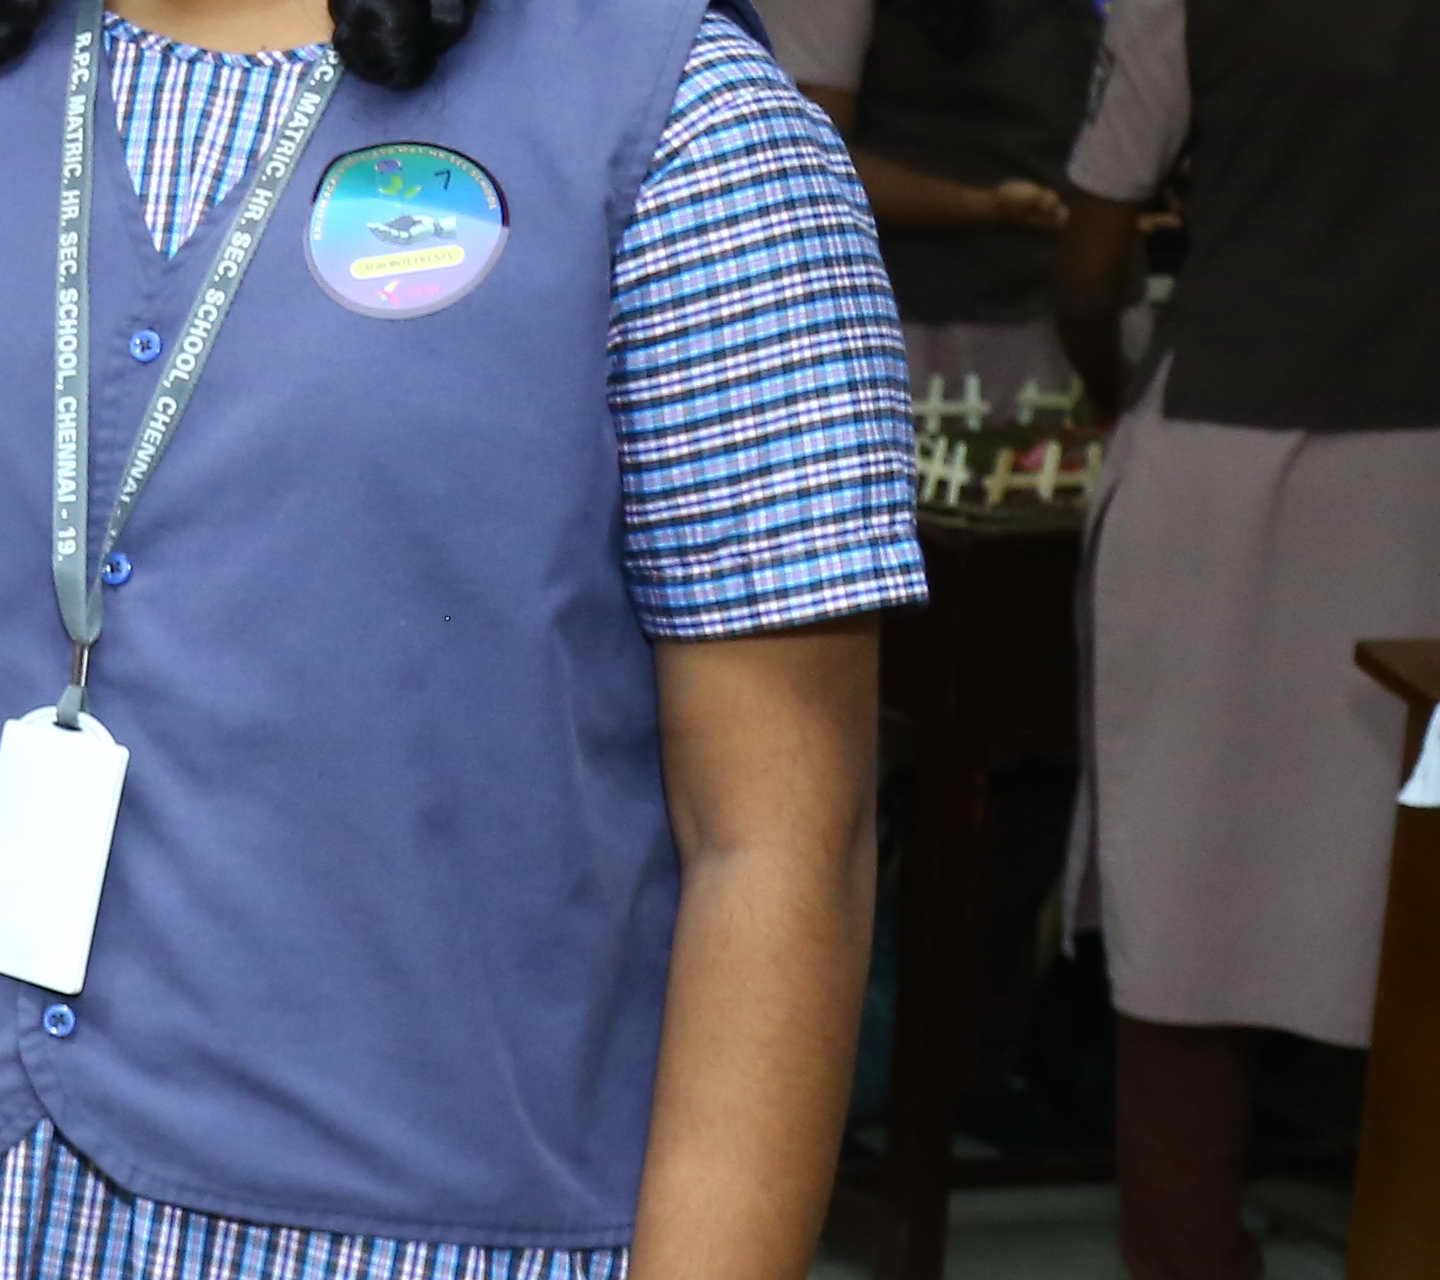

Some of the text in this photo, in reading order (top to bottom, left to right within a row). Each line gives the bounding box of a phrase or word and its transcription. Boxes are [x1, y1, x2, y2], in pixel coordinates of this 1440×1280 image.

[71, 31, 93, 91] R.P.C.
[63, 94, 87, 185] MATRIC.
[261, 90, 322, 182] MATRIC.
[60, 189, 81, 227] HR.
[240, 187, 273, 225] HR.
[58, 231, 79, 283] SEC.
[214, 228, 253, 282] SEC.
[56, 287, 79, 391] SCHOOL,
[163, 287, 226, 389] SCHOOL,
[56, 396, 78, 503] CHENNAI
[120, 396, 178, 503] CHENNAI
[57, 525, 77, 561] 19.
